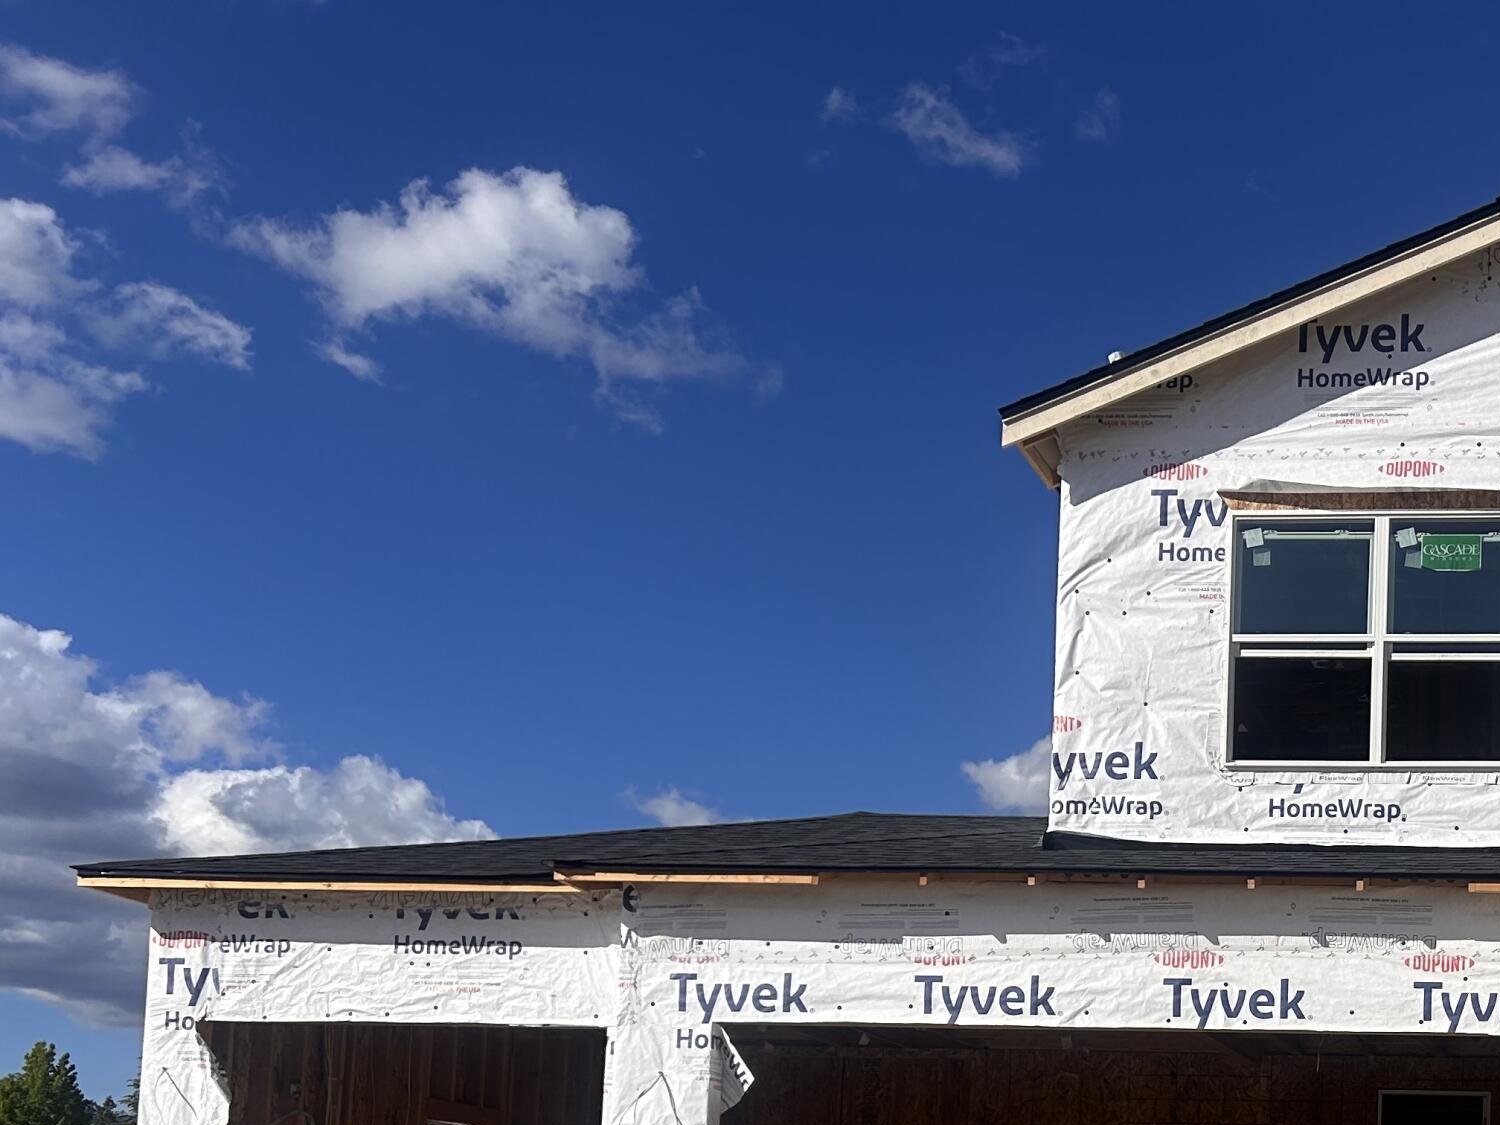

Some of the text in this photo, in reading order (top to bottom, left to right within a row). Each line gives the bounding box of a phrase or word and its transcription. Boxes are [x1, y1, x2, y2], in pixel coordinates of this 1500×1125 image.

[1298, 313, 1426, 364] Tyvek
[1297, 368, 1430, 391] HomeWrap
[1151, 464, 1202, 481] DUPONT
[1387, 460, 1439, 477] DUPONT
[1158, 542, 1226, 562] Home
[1423, 543, 1480, 559] CASCADE
[1052, 742, 1158, 790] yvek
[1268, 798, 1401, 823] HomeWrap
[159, 931, 209, 949] DUPONT
[394, 935, 523, 959] HomeWrap
[1163, 951, 1216, 969] DUPONT
[1413, 955, 1467, 973] DUPONT
[670, 973, 808, 1024] Tyvek
[914, 975, 1056, 1025] Tyvek
[1163, 978, 1306, 1030] Tyvek
